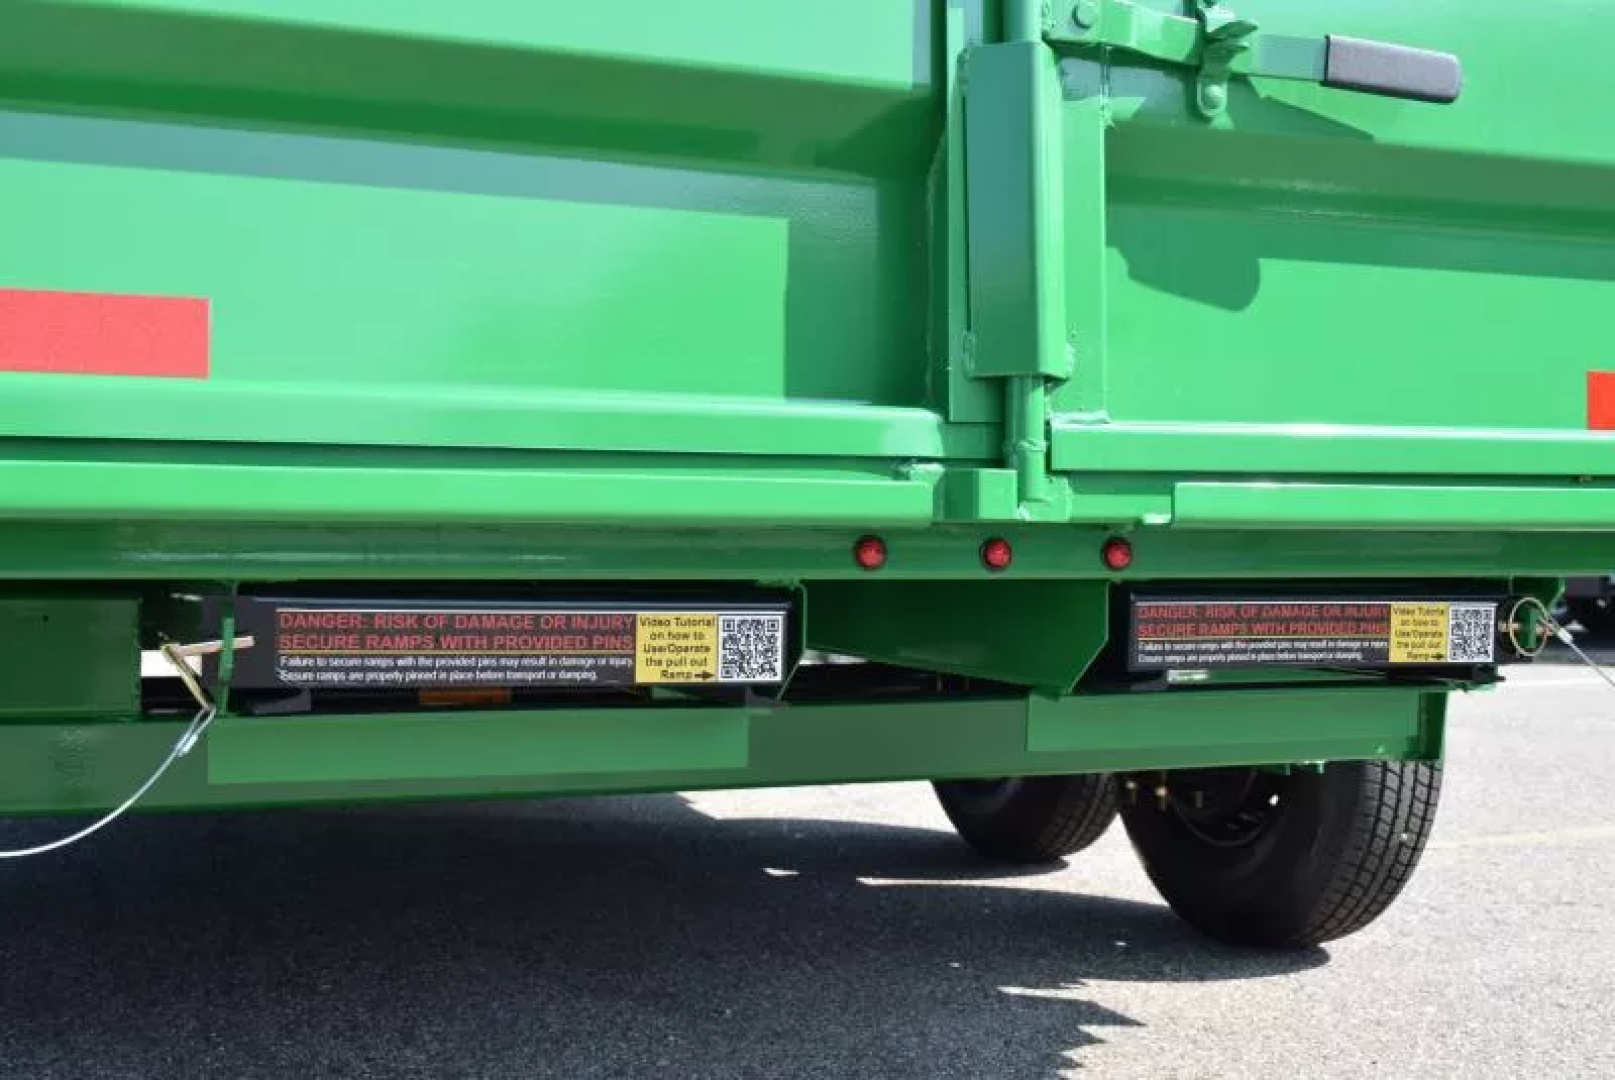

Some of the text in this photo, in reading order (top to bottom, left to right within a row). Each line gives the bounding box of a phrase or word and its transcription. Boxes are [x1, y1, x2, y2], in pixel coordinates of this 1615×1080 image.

[374, 613, 419, 629] RISK
[425, 613, 448, 629] OF
[455, 613, 534, 629] DAMAGE
[541, 613, 567, 629] OR
[572, 613, 632, 629] INJURY
[640, 616, 716, 627] Video Tutorial
[279, 634, 632, 649] SECURE RAMPS WITH PROVIDED PINS
[649, 631, 706, 641] on how to
[645, 657, 708, 669] the pull out
[660, 669, 693, 681] Ramp
